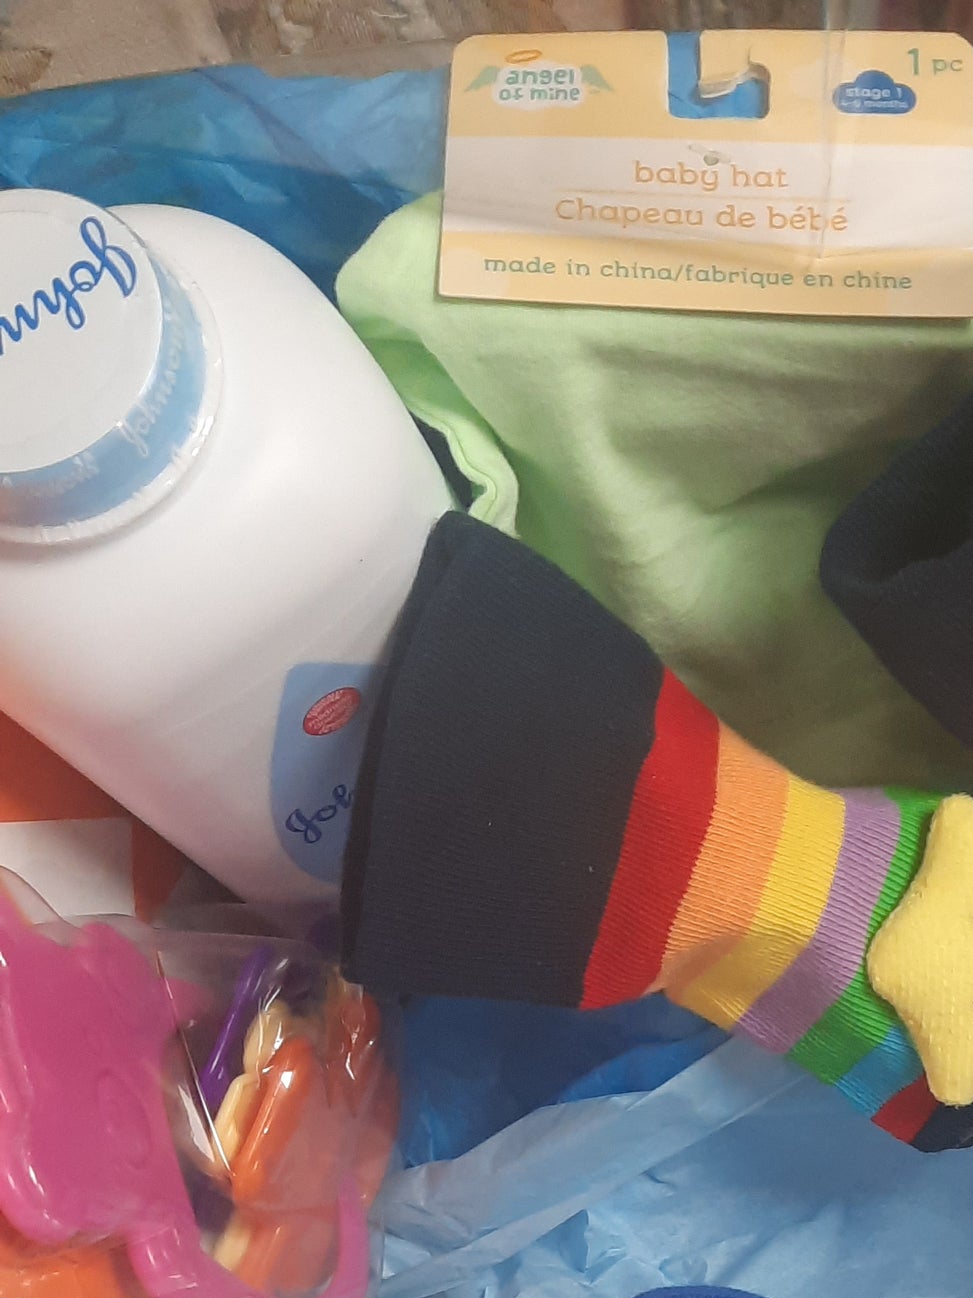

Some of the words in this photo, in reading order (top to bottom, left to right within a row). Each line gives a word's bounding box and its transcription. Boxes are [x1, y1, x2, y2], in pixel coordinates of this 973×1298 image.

[504, 65, 576, 86] angel
[906, 47, 920, 75] 1
[931, 55, 963, 76] pc
[499, 85, 523, 101] of
[530, 83, 580, 102] mine
[846, 87, 891, 100] stage
[633, 160, 719, 192] baby
[730, 163, 789, 189] hat
[555, 197, 703, 230] Chapeau
[716, 204, 755, 229] de
[767, 204, 848, 233] bébé
[0, 214, 138, 355] John
[483, 256, 557, 276] made
[565, 258, 591, 277] in
[600, 260, 795, 290] china/fabrique
[803, 273, 833, 288] en
[843, 270, 913, 291] chine
